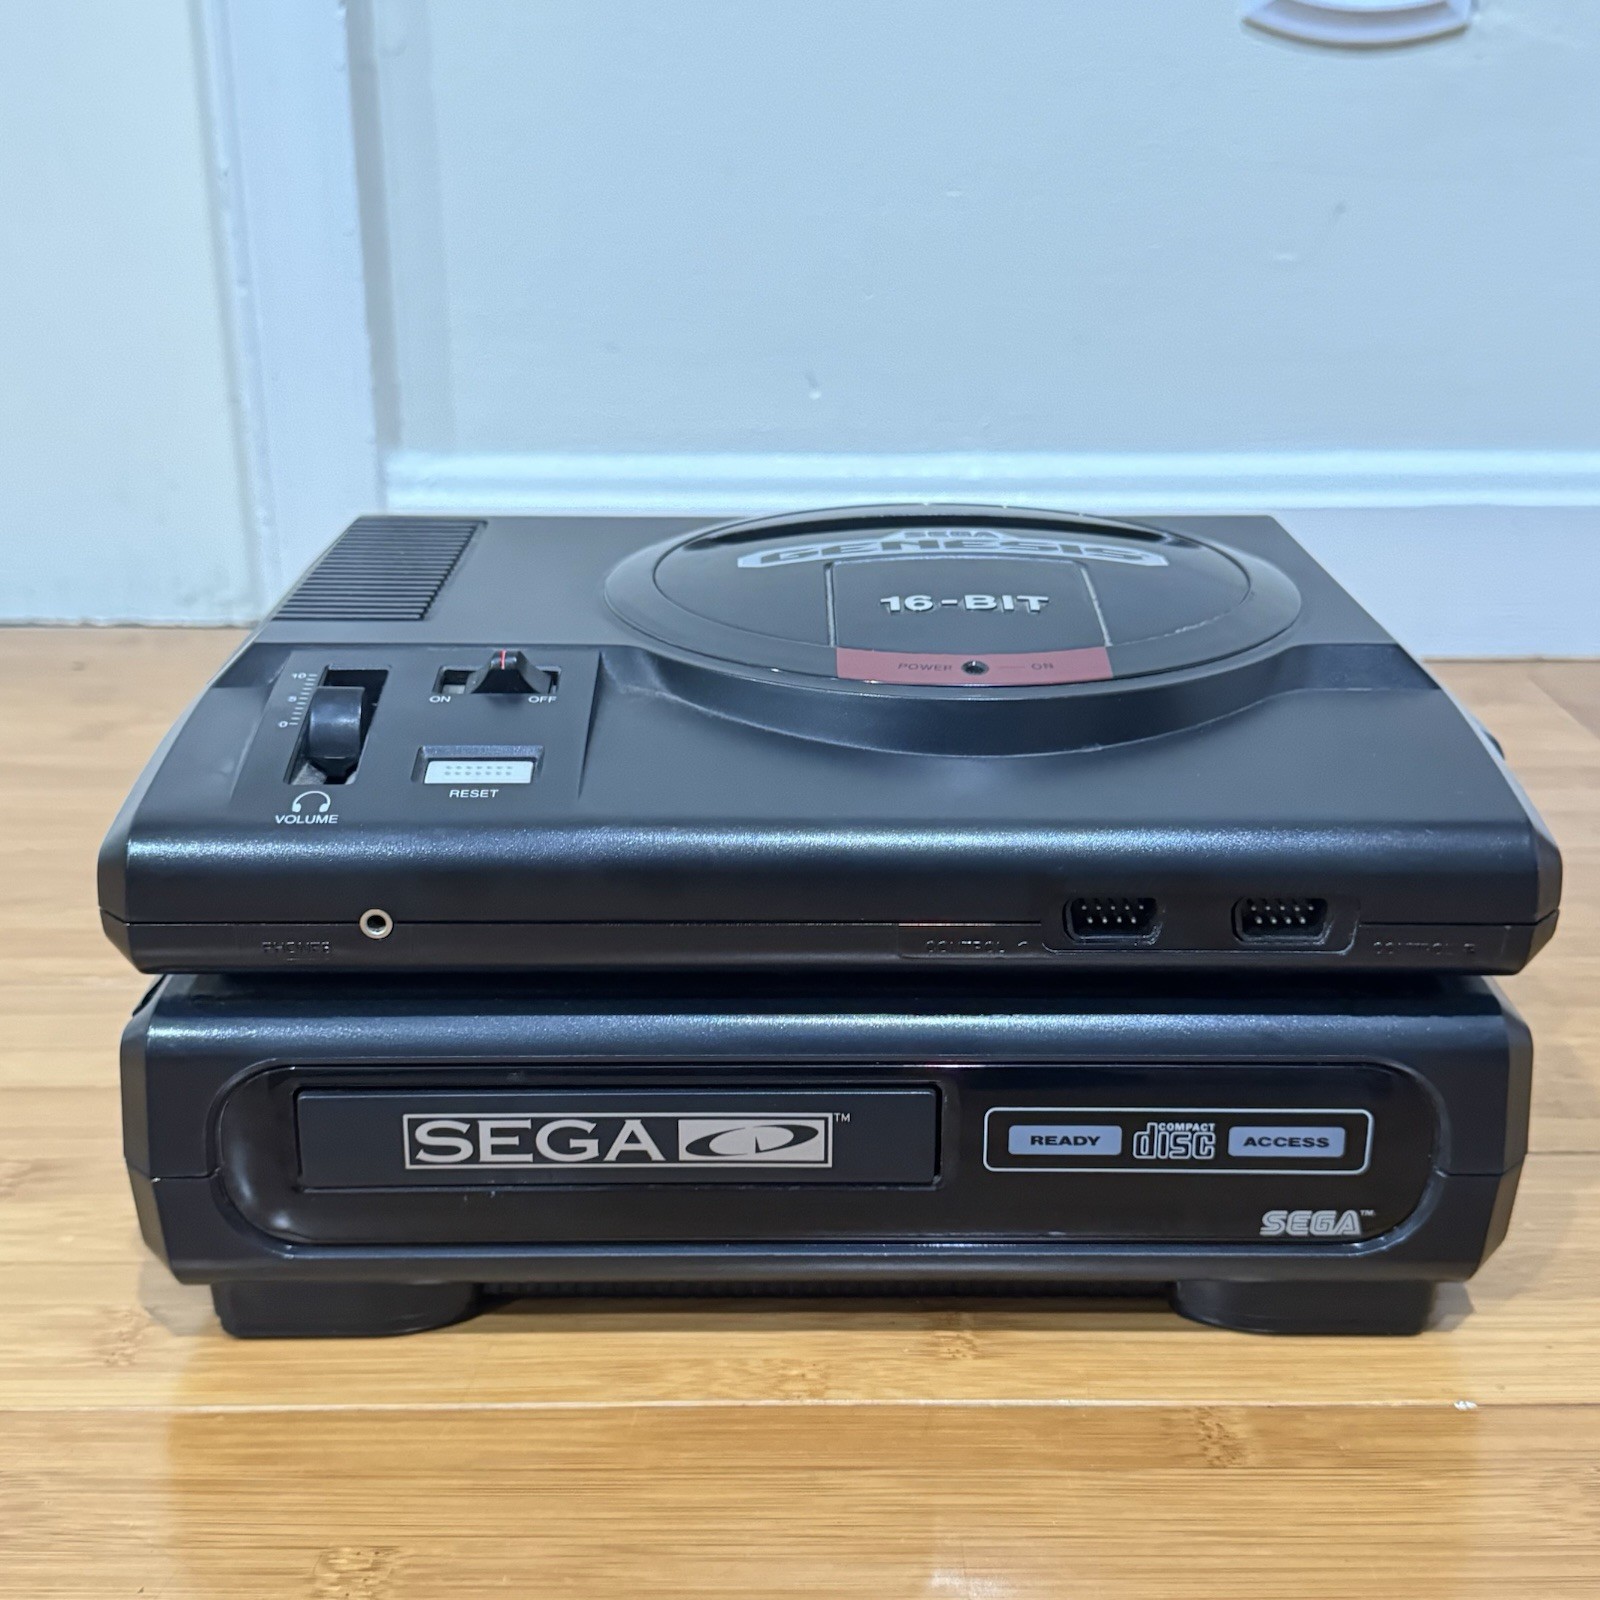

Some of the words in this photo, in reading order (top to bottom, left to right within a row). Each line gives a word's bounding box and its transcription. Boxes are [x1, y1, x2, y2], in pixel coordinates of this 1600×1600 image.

[903, 530, 1001, 539] SEGA
[760, 539, 1143, 564] GENESIS
[880, 594, 1049, 612] 16-BIT
[897, 662, 953, 672] POWER
[1030, 662, 1054, 670] ON
[429, 695, 451, 703] ON
[528, 695, 557, 703] OFF
[449, 788, 499, 798] RESET
[275, 814, 339, 824] VOLUME
[1158, 1122, 1215, 1131] COMPACT
[415, 1119, 666, 1163] SEGA
[1030, 1136, 1101, 1146] READY
[1132, 1122, 1215, 1160] disc
[1243, 1136, 1330, 1147] ACCESS
[1259, 1210, 1362, 1236] SEGA
